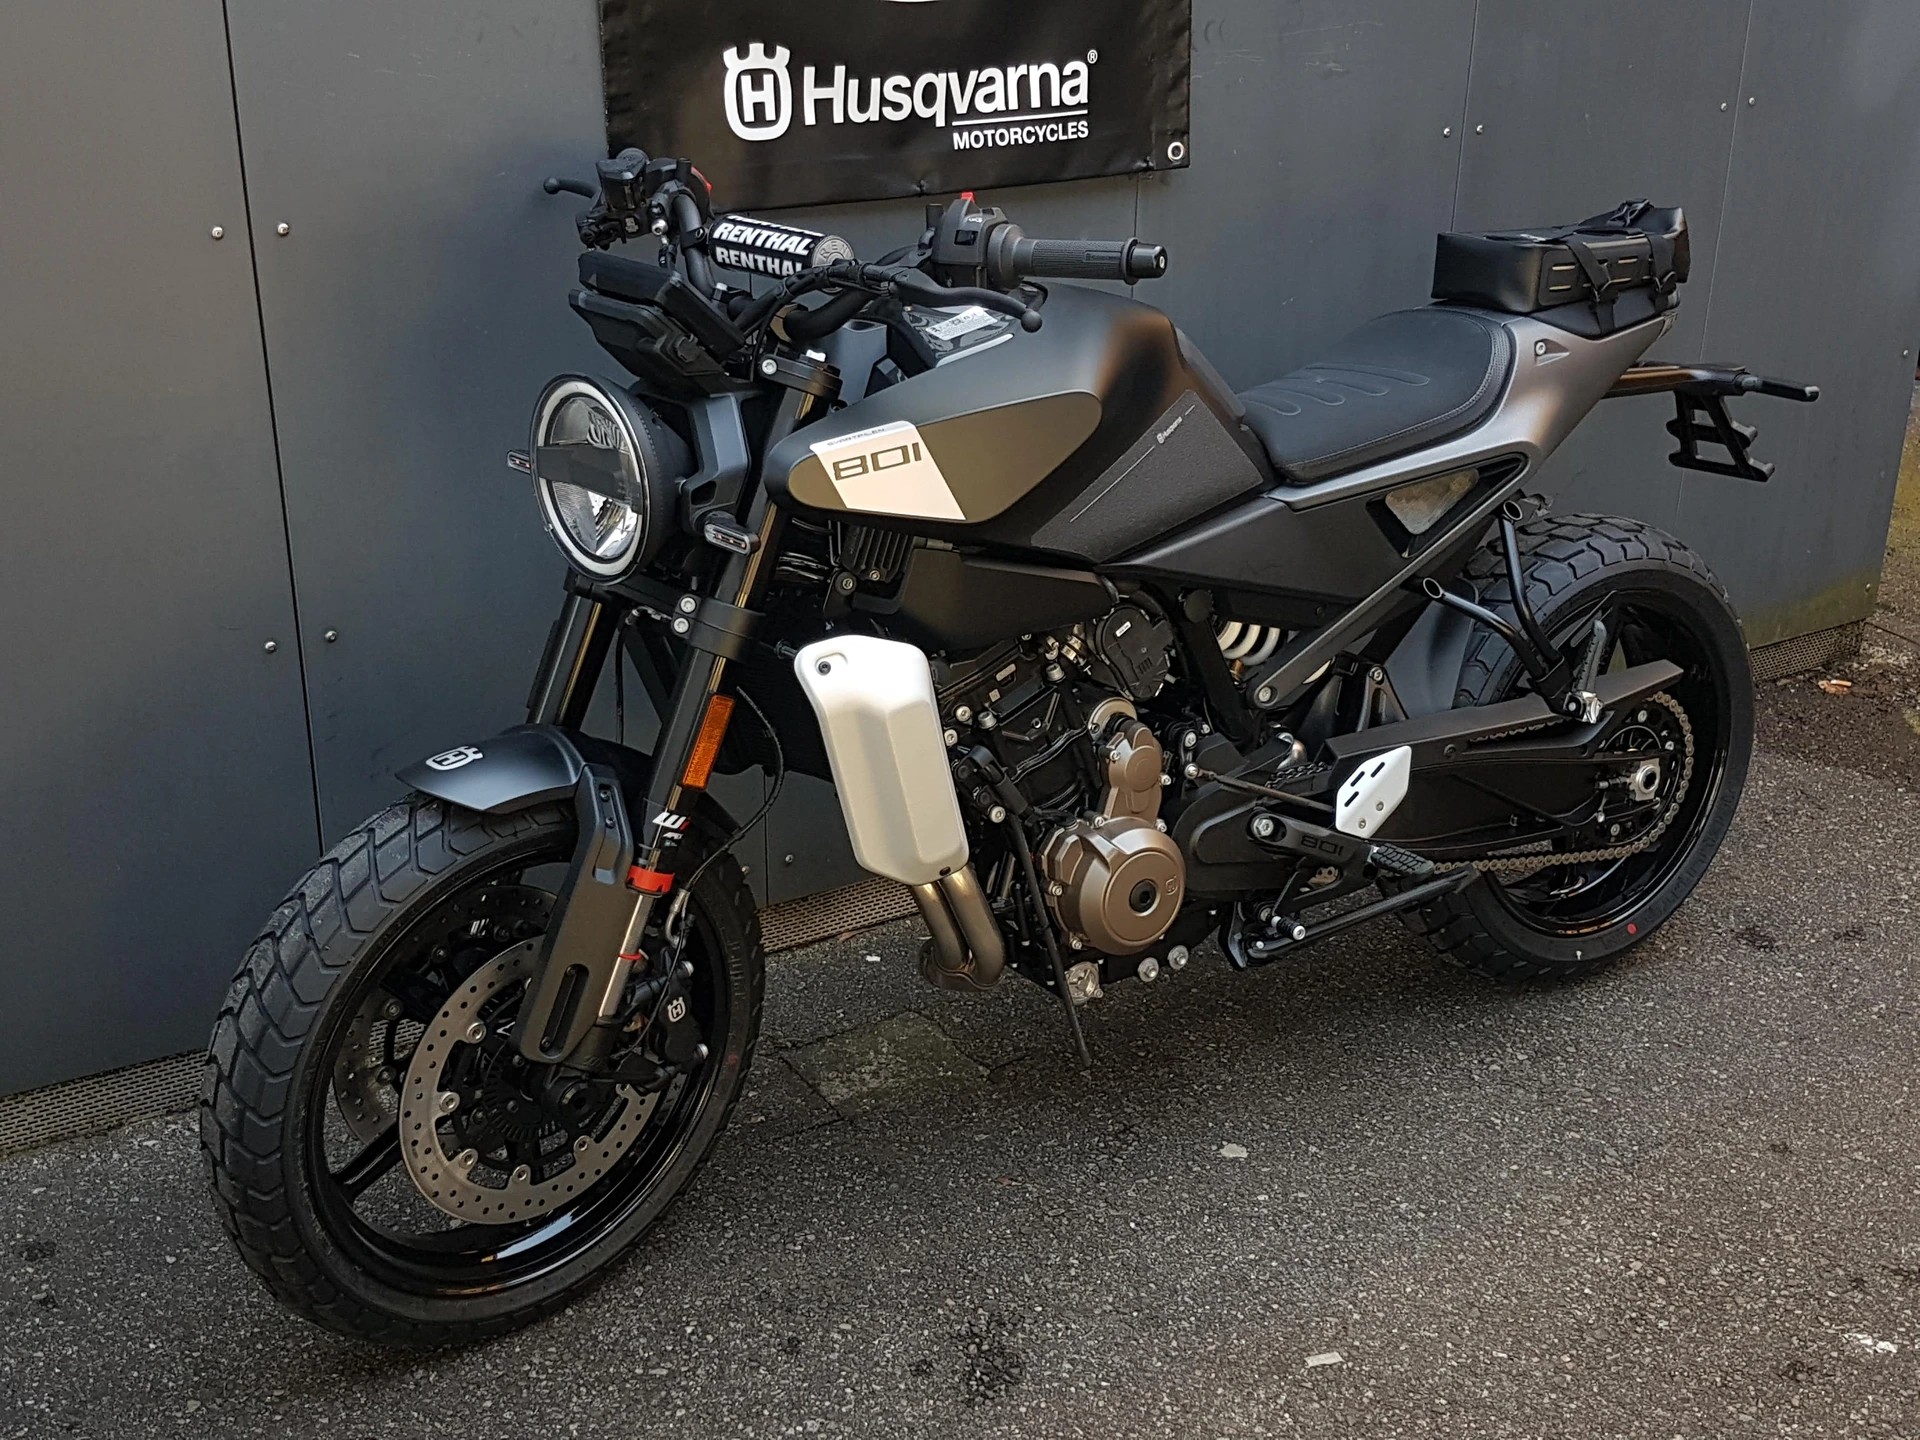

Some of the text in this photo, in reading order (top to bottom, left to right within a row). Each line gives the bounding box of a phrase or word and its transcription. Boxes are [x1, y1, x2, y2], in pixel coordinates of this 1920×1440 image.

[952, 120, 1089, 150] MOTORCYCLES
[712, 222, 813, 256] RENTHAL
[832, 442, 922, 481] 801
[1301, 833, 1345, 857] 801
